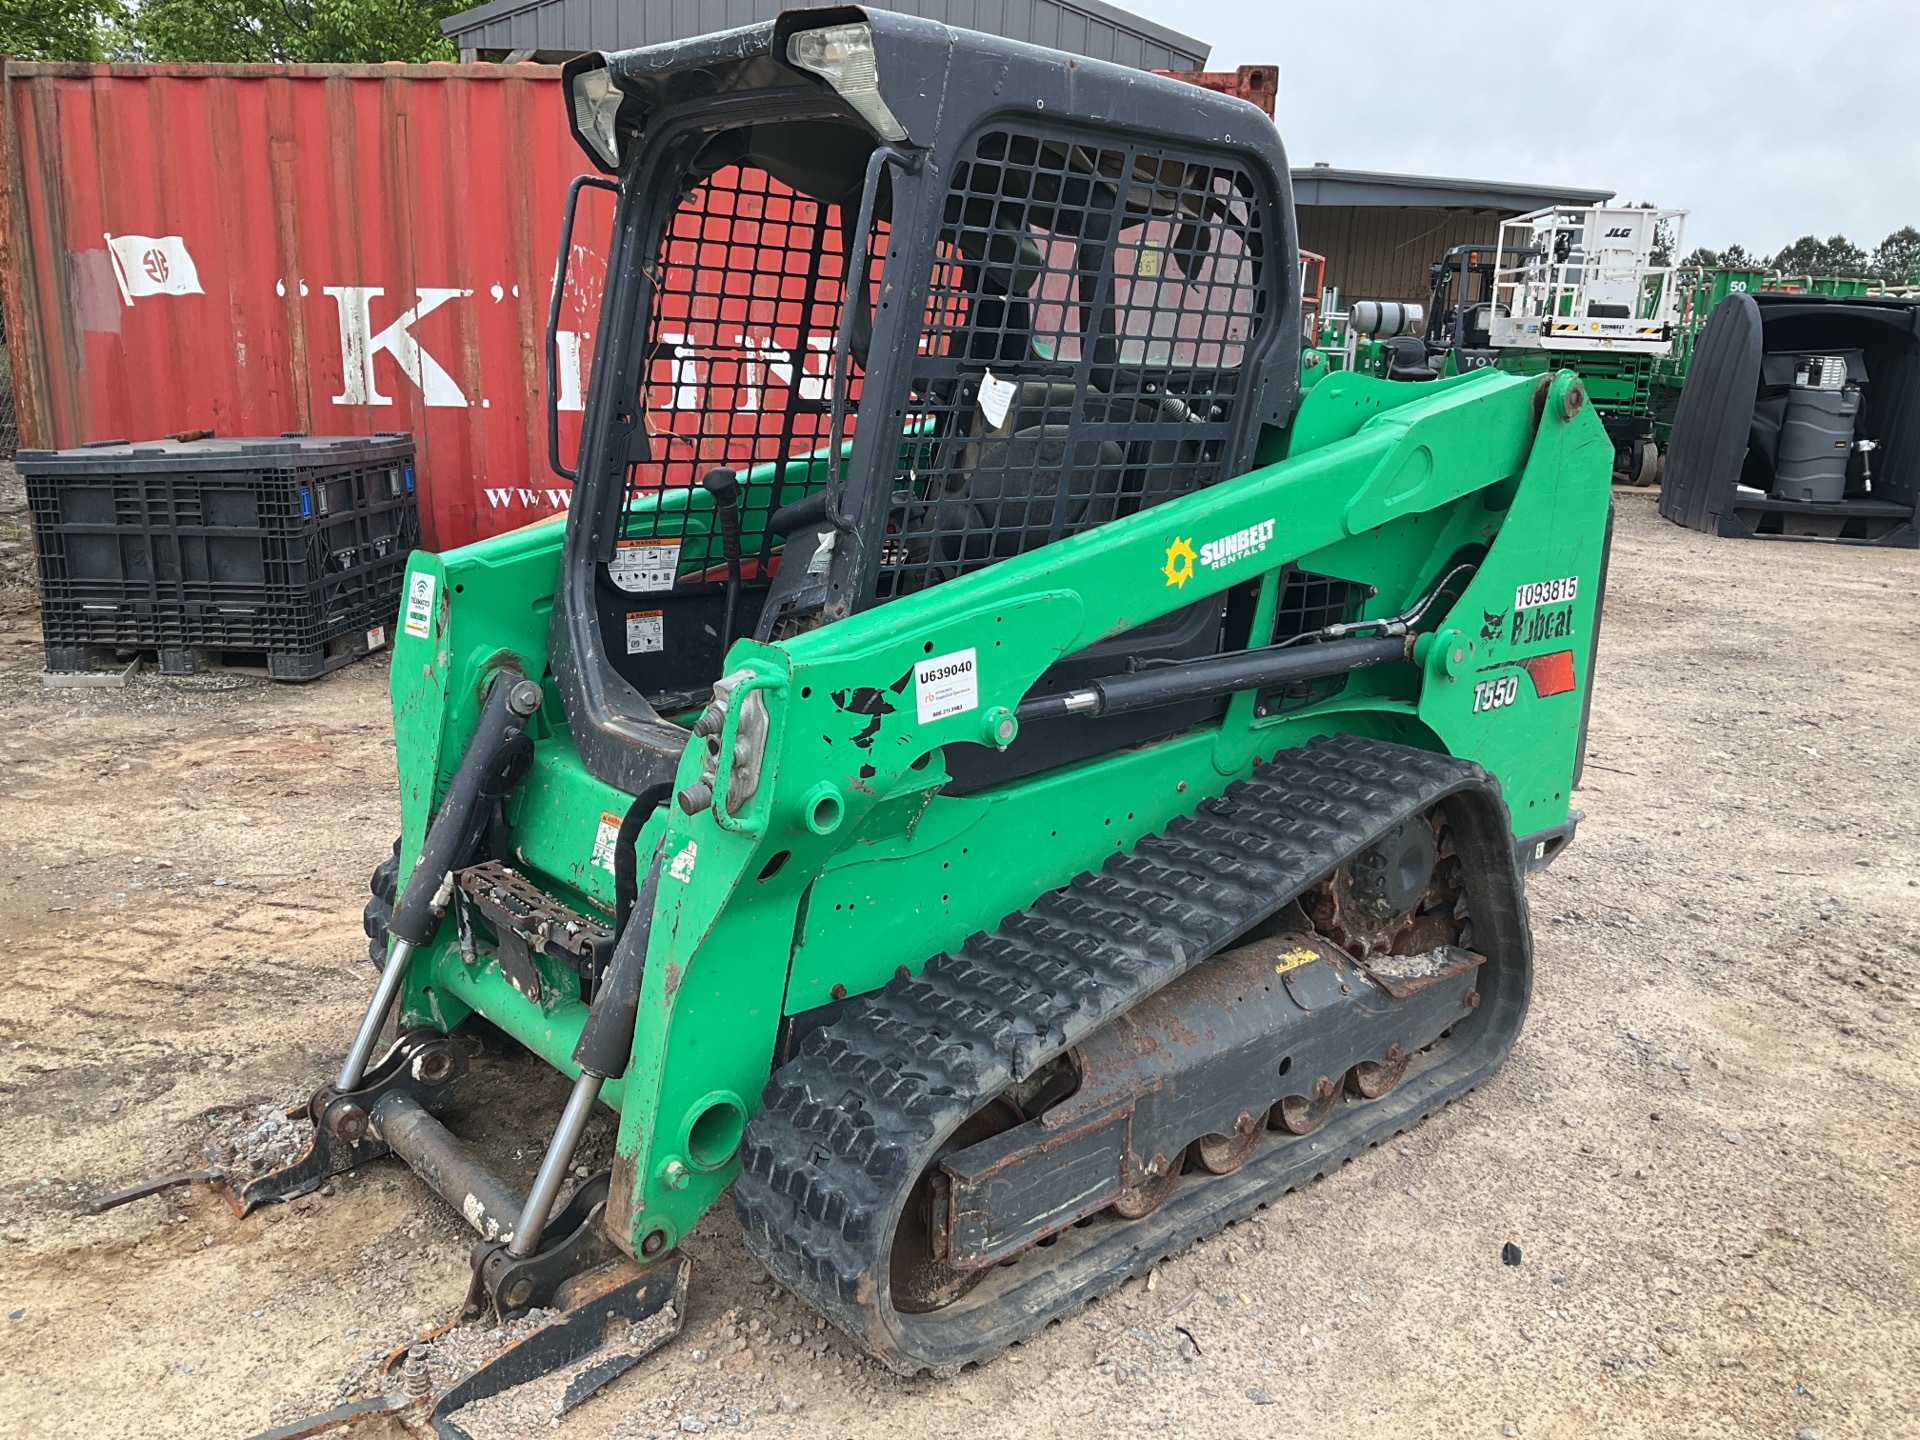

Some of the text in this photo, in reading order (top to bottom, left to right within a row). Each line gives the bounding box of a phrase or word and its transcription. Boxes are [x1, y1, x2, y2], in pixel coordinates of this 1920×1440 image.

[1604, 228, 1632, 237] JLG
[1730, 281, 1747, 293] 50
[1200, 518, 1276, 566] SUNBELT
[1211, 542, 1266, 570] RENTALS
[1517, 577, 1577, 608] 1093815
[635, 610, 659, 618] WARNING
[1510, 604, 1574, 646] Bobcat
[920, 660, 972, 684] U639040
[1472, 675, 1519, 714] T550
